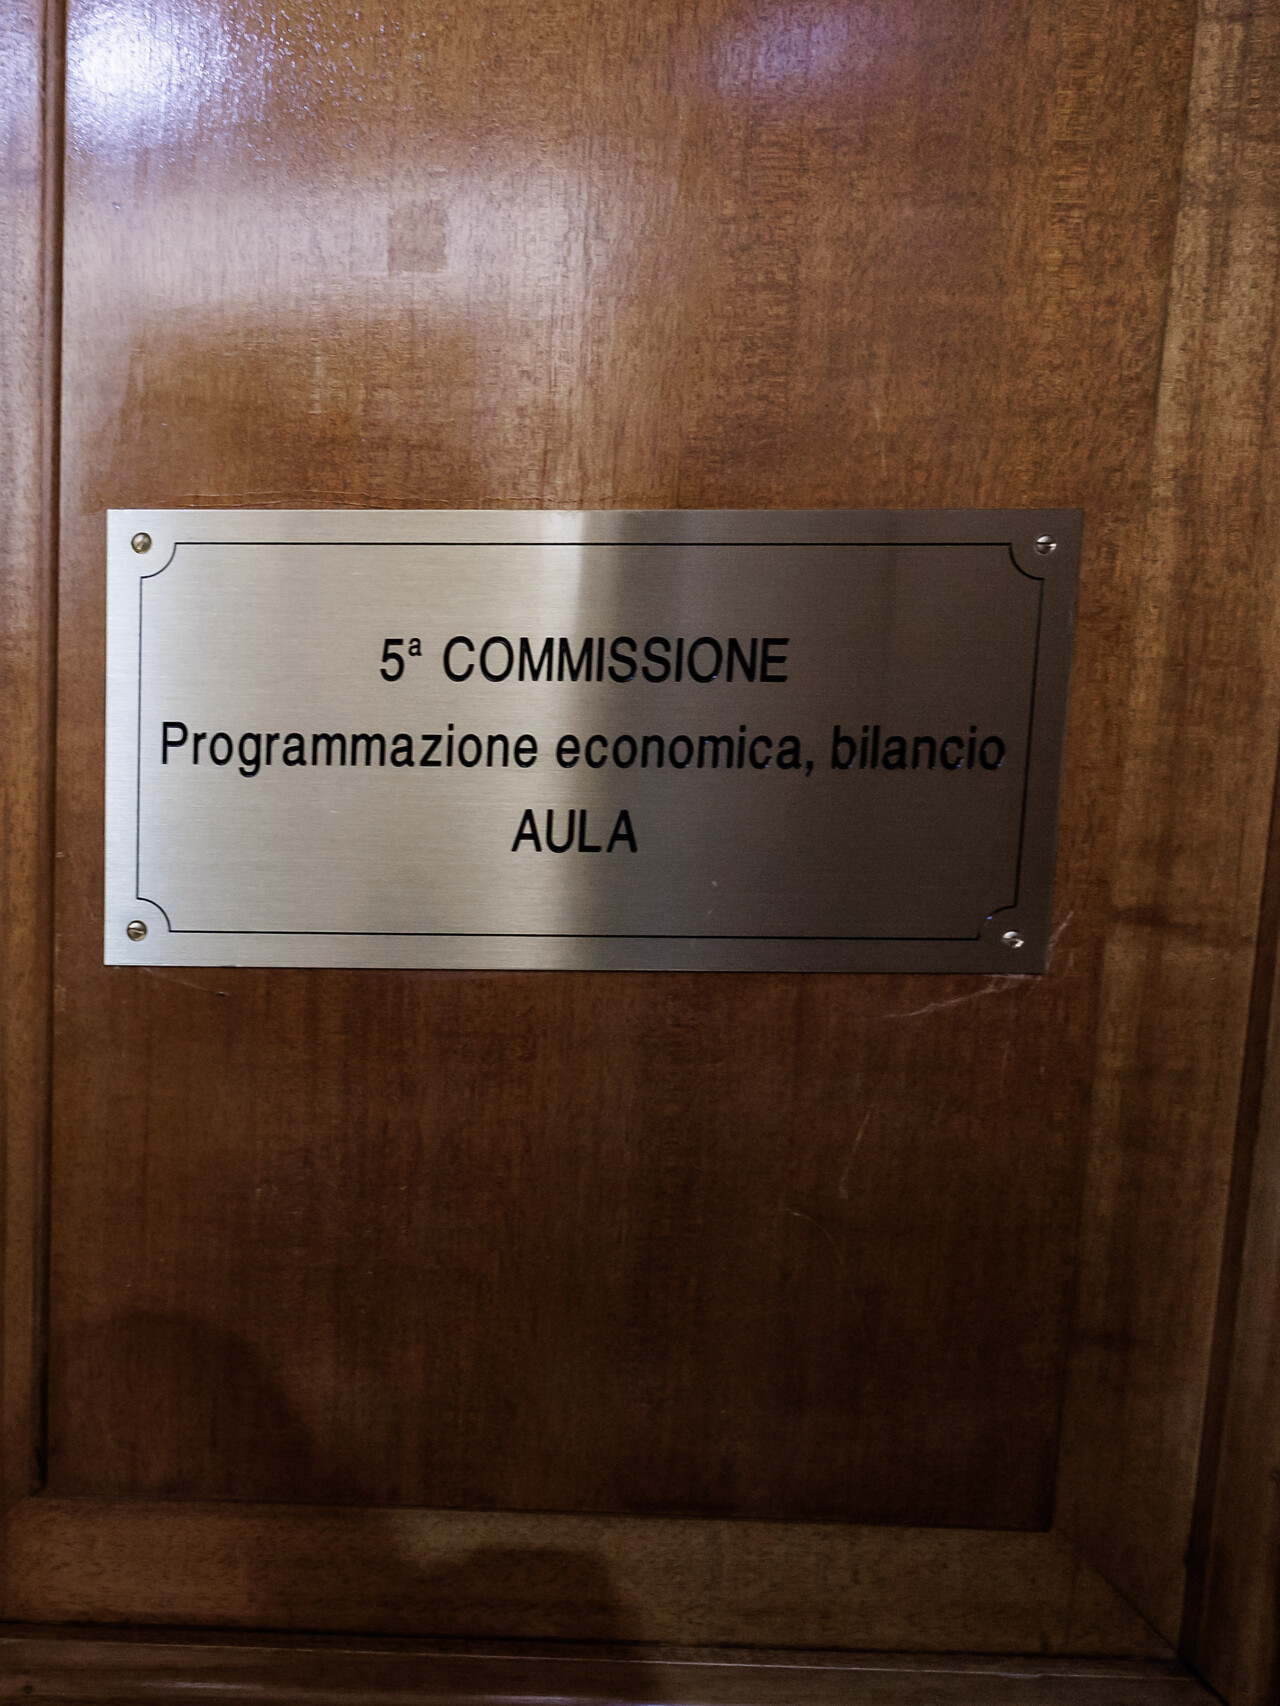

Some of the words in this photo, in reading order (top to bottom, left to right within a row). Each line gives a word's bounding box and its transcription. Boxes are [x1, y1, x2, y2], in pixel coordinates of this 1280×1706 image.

[442, 636, 790, 684] COMMISSIONE
[161, 721, 539, 779] Programmazione
[555, 724, 814, 777] economica,
[832, 724, 1005, 771] bilancio
[510, 808, 638, 854] AULA
